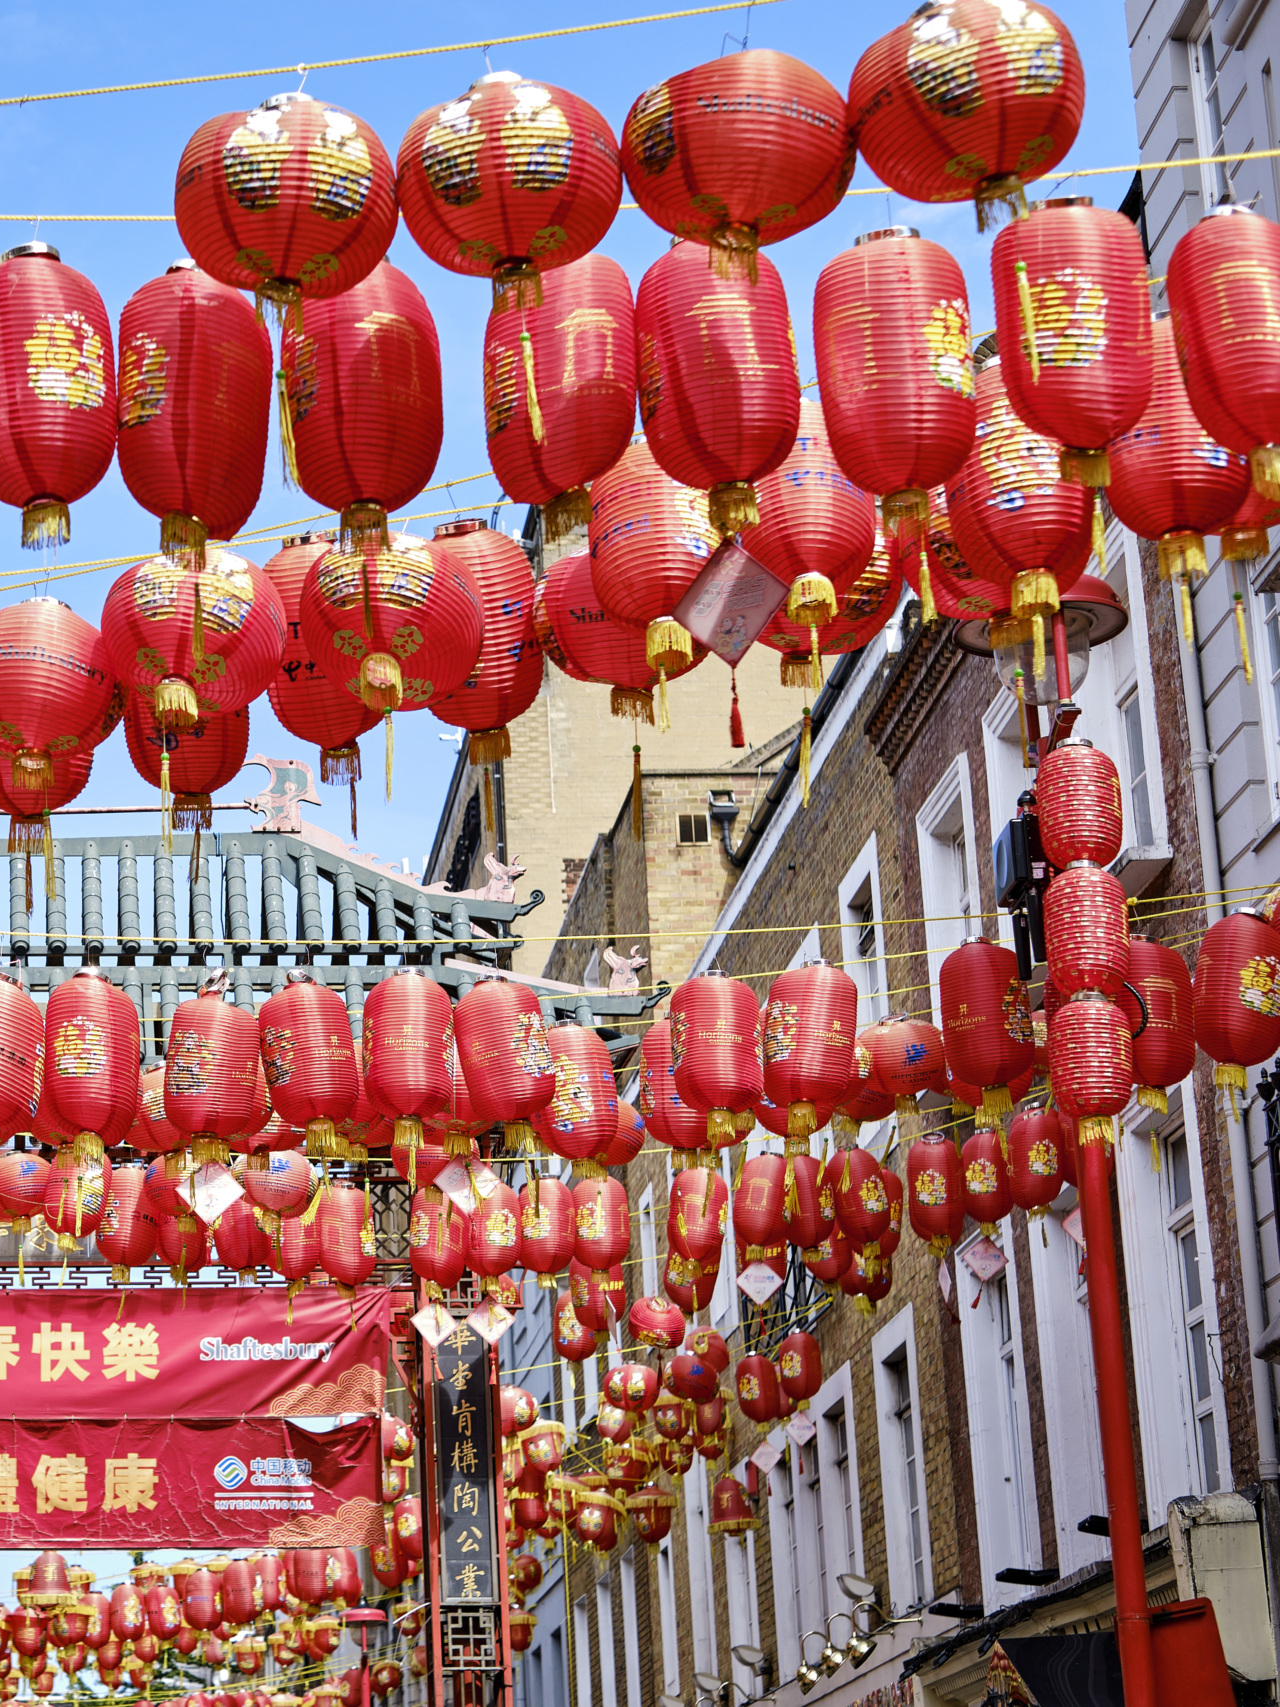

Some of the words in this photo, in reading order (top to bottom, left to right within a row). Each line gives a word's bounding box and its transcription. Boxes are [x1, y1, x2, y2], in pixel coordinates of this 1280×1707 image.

[696, 92, 838, 136] Shaftesbury
[948, 1015, 987, 1028] Horizons
[384, 1037, 430, 1048] Horizons
[698, 1030, 743, 1043] Horizons
[891, 1069, 940, 1080] HIPPODROME
[264, 1187, 291, 1196] CASINO
[200, 1336, 335, 1363] Shaftesbury
[443, 1318, 485, 1598] 華堂肯構陶公業
[250, 1457, 313, 1475] 中国移动
[250, 1474, 280, 1486] China
[280, 1474, 313, 1486] Mobile
[214, 1500, 314, 1511] INTERNATIONAL
